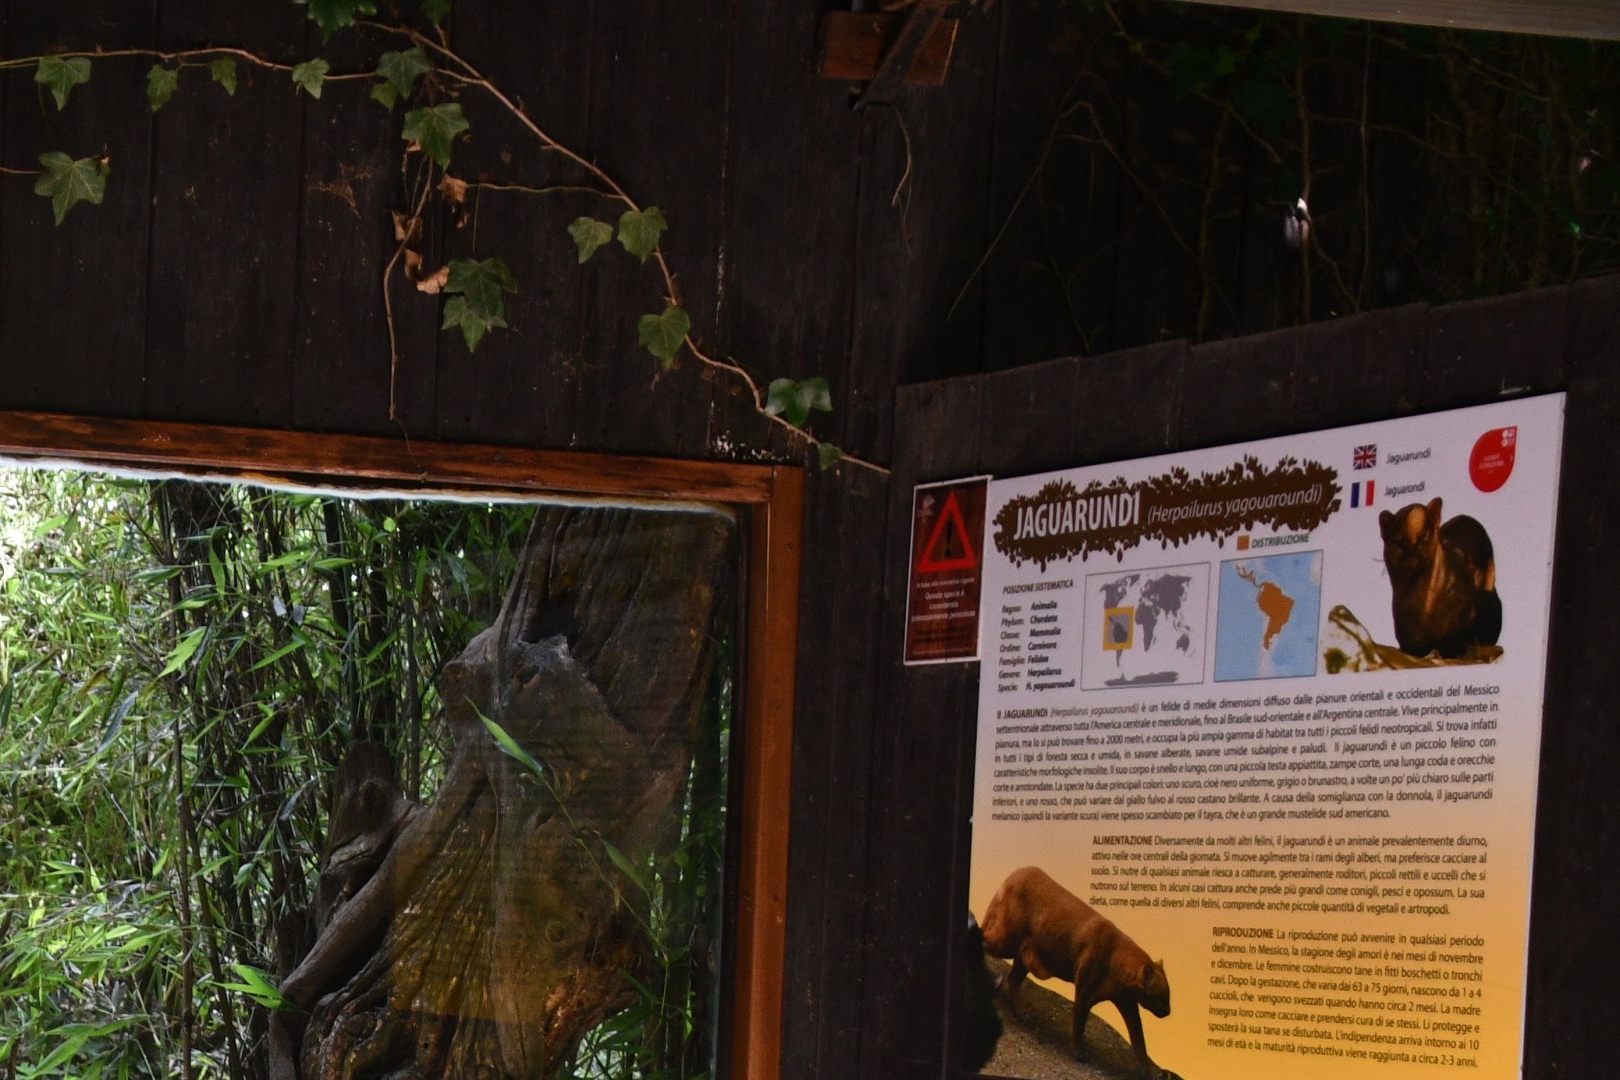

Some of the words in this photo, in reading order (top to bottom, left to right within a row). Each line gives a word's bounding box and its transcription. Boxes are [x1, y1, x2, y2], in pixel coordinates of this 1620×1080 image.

[1386, 448, 1431, 466] Jaguarundi
[1385, 481, 1425, 498] Jaguarondi
[1014, 492, 1140, 540] JAGUARUNDI
[1148, 497, 1224, 525] (Herpailurus
[1225, 484, 1323, 517] yagouaroundi)
[1252, 533, 1310, 548] DISTRIBUZIONE
[1002, 584, 1035, 595] POSIZIONE
[1035, 580, 1073, 592] SISTEMATICA
[1003, 709, 1048, 719] JAGUARUNDI
[1148, 704, 1158, 712] un
[1160, 700, 1181, 712] felide
[1182, 699, 1191, 711] di
[1192, 698, 1217, 710] medie
[1218, 696, 1261, 709] dimensioni
[1263, 695, 1291, 707] diffuso
[1293, 693, 1313, 705] dalle
[1315, 693, 1347, 707] pianure
[1349, 690, 1384, 702] orientali
[1395, 686, 1443, 700] occidentali
[1445, 686, 1461, 697] del
[1463, 684, 1499, 696] Messico
[994, 753, 1001, 763] in
[1002, 752, 1017, 763] tutti
[1023, 751, 1035, 765] tipi
[1036, 751, 1043, 762] di
[1045, 751, 1068, 762] foresta
[1070, 753, 1088, 761] secca
[1097, 749, 1121, 761] umida,
[1123, 749, 1131, 759] in
[1133, 751, 1158, 759] savane
[1160, 747, 1192, 758] alberate,
[1195, 749, 1221, 757] savane
[1223, 745, 1248, 756] umide
[1250, 744, 1289, 758] subalpine
[1299, 742, 1327, 757] paludi.
[1342, 740, 1388, 755] jaguarundi
[1399, 742, 1412, 750] un
[1414, 738, 1447, 753] piccolo
[1450, 738, 1476, 749] felino
[1478, 739, 1496, 747] con
[1092, 836, 1153, 845] ALIMENTAZIONE
[1154, 834, 1204, 846] Diversamente
[1205, 834, 1215, 846] da
[1216, 834, 1236, 846] molti
[1237, 834, 1253, 846] altri
[1253, 835, 1274, 847] felini,
[1282, 835, 1326, 849] jaguarundi
[1334, 838, 1345, 846] un
[1346, 835, 1380, 846] animale
[1381, 835, 1454, 849] prevalentemente
[1456, 835, 1487, 847] diurno,
[1089, 879, 1118, 891] nutrono
[1118, 880, 1129, 891] sul
[1130, 880, 1158, 892] terreno.
[1159, 881, 1166, 892] In
[1167, 881, 1190, 892] alcuni
[1191, 882, 1206, 893] casi
[1206, 882, 1233, 893] cattura
[1234, 883, 1258, 894] anche
[1258, 883, 1282, 897] prede
[1283, 884, 1297, 897] più
[1297, 884, 1324, 898] grandi
[1325, 887, 1348, 896] come
[1349, 885, 1379, 899] conigli,
[1381, 886, 1403, 899] pesci
[1412, 889, 1454, 900] opossum.
[1456, 887, 1467, 898] La
[1469, 890, 1485, 898] sua
[1212, 928, 1274, 939] RIPRODUZIONE
[1276, 928, 1285, 939] La
[1287, 928, 1338, 943] riproduzione
[1340, 930, 1358, 945] può
[1360, 932, 1395, 943] avvenire
[1398, 932, 1406, 944] in
[1409, 933, 1446, 947] qualsiasi
[1449, 935, 1484, 949] periodo
[1211, 941, 1247, 954] dell'anno.
[1248, 943, 1256, 954] In
[1257, 943, 1290, 957] Messico,
[1291, 945, 1299, 956] la
[1300, 945, 1334, 960] stagione
[1335, 947, 1356, 961] degli
[1357, 949, 1382, 960] amori
[1390, 949, 1404, 961] nei
[1405, 950, 1426, 962] mesi
[1427, 951, 1437, 962] di
[1438, 952, 1483, 964] novembre
[1216, 957, 1254, 970] dicembre.
[1255, 959, 1264, 971] Le
[1265, 960, 1301, 972] femmine
[1301, 962, 1353, 975] costruiscono
[1353, 964, 1373, 976] tane
[1374, 965, 1383, 976] in
[1384, 965, 1399, 977] fitti
[1400, 966, 1442, 980] boschetti
[1450, 969, 1482, 982] tronchi
[1209, 990, 1239, 1002] cuccioli,
[1239, 991, 1254, 1002] che
[1257, 994, 1292, 1006] vengono
[1292, 995, 1324, 1006] svezzati
[1325, 996, 1357, 1009] quando
[1358, 997, 1385, 1010] hanno
[1386, 999, 1407, 1011] circa
[1415, 1002, 1438, 1013] mesi.
[1440, 1003, 1451, 1014] La
[1452, 1005, 1481, 1016] madre
